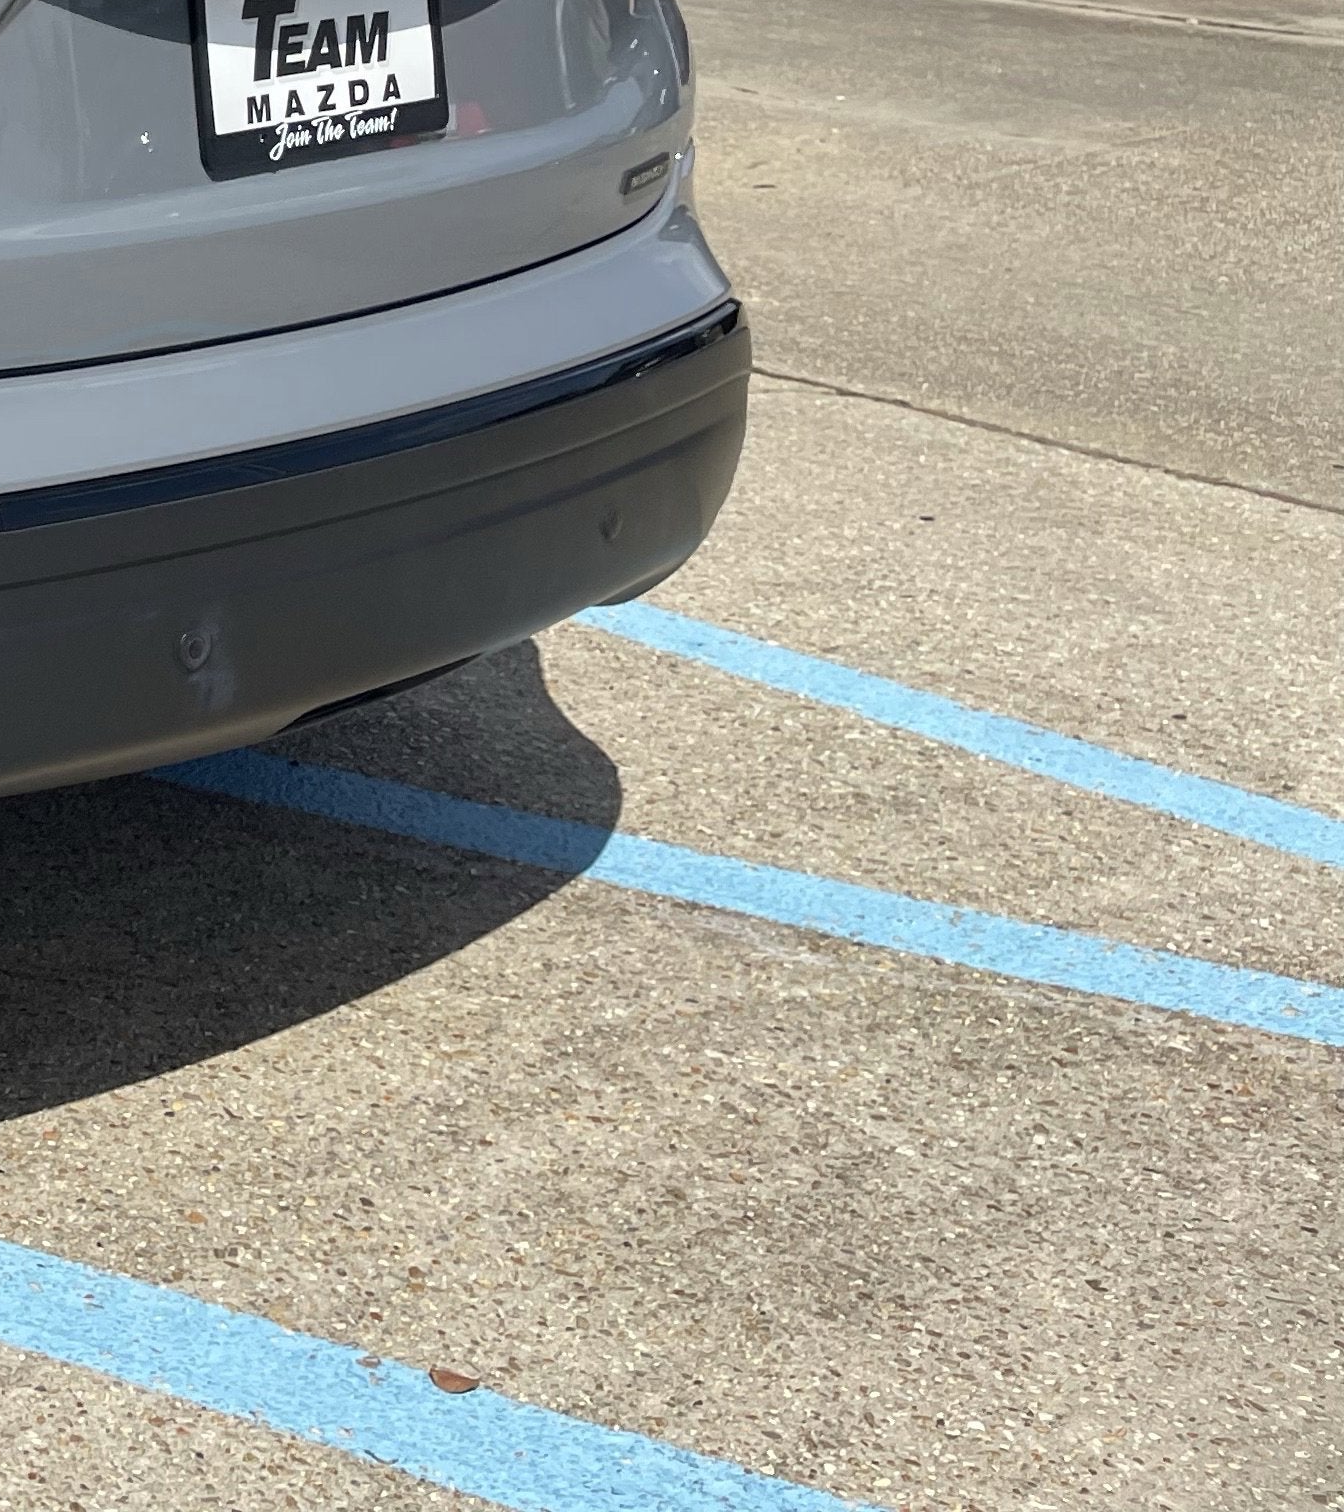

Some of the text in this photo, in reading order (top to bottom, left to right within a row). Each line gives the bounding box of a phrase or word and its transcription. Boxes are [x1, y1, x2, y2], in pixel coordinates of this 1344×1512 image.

[246, 73, 401, 124] MAZDA
[269, 107, 399, 161] Join The Team!
